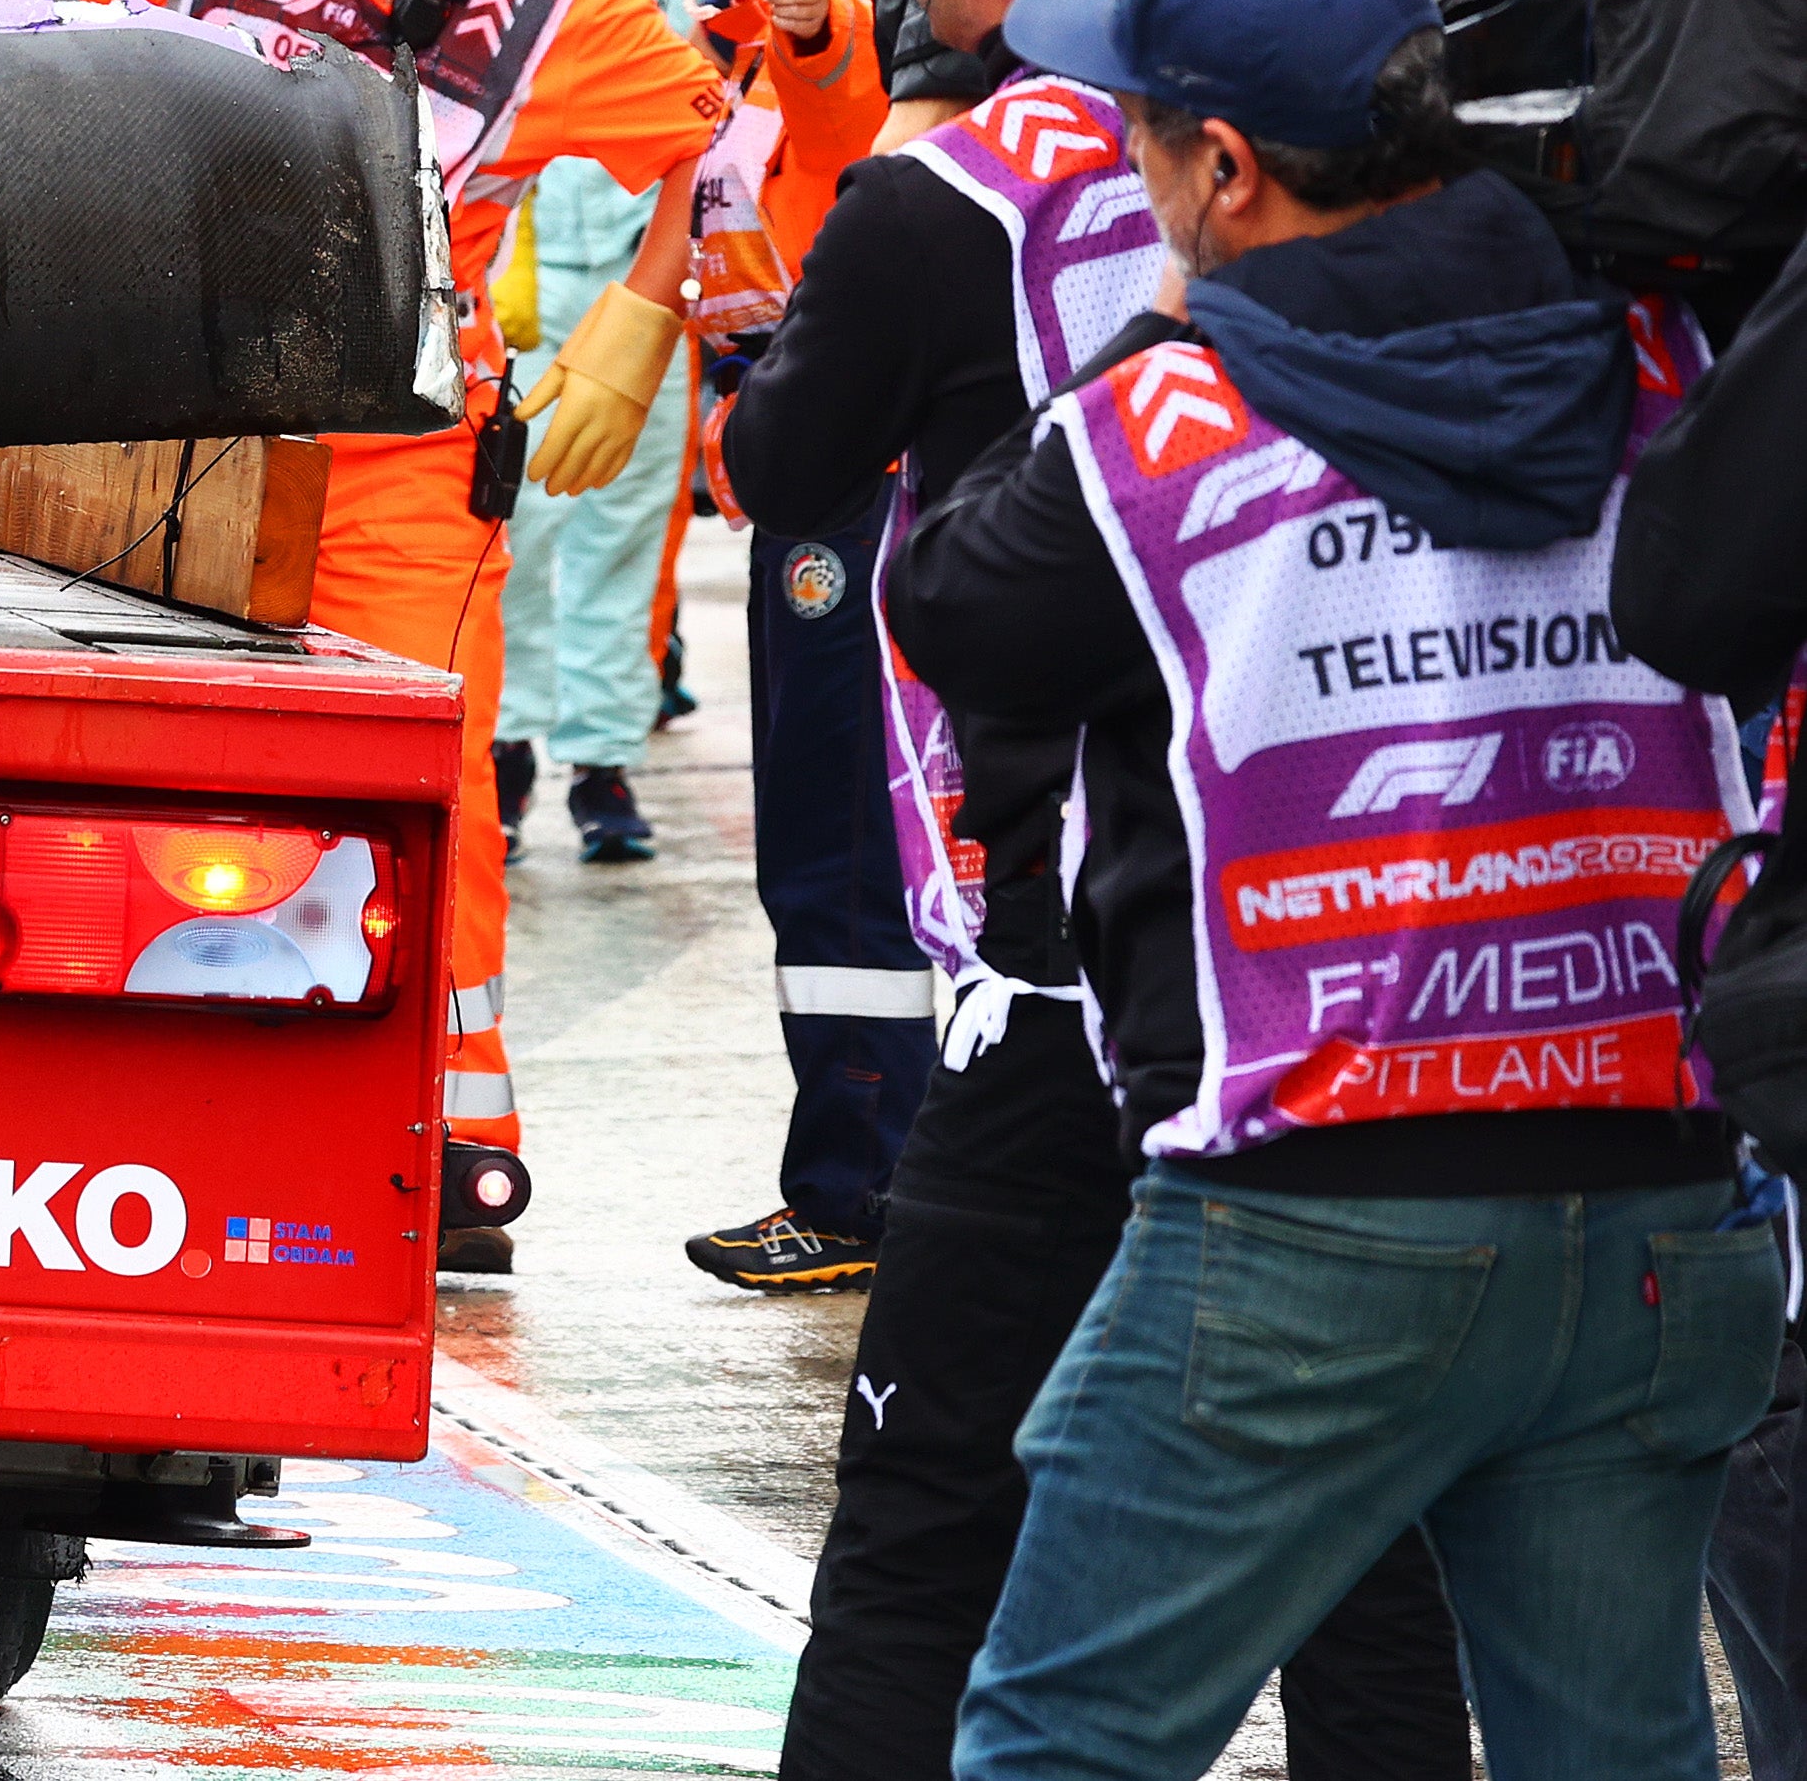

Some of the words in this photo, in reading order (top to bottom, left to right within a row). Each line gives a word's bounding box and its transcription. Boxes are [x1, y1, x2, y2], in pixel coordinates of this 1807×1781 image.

[1298, 613, 1631, 697] TELEVISION
[1408, 921, 1680, 1022] MEDIA
[1331, 1051, 1424, 1098] PIT
[1453, 1033, 1624, 1095] LANE
[273, 1245, 355, 1266] OBDAM
[274, 1222, 332, 1241] STAM
